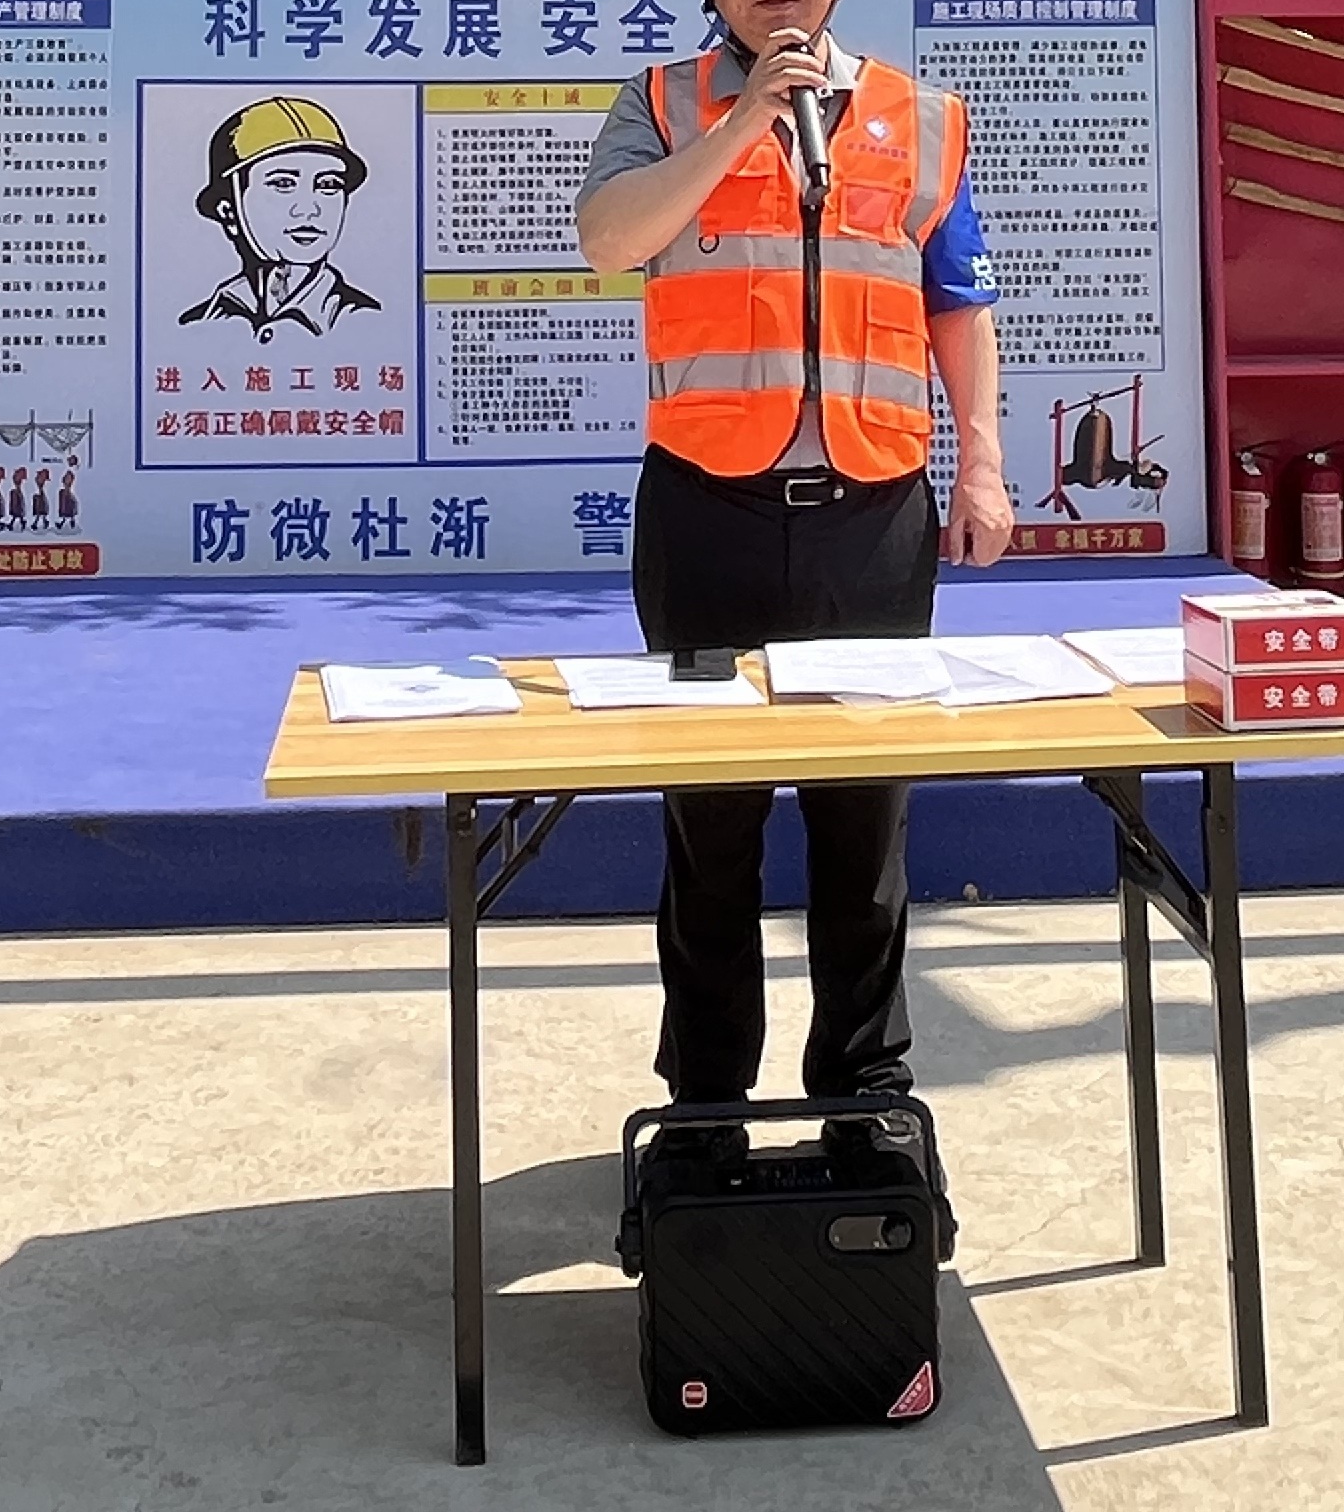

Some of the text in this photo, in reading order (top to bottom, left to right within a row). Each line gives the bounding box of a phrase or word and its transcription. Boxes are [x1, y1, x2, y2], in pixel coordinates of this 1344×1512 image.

[156, 366, 405, 393] 进入施工现场
[156, 410, 405, 437] 必须正确佩戴安全帽
[191, 496, 492, 564] 防微杜渐
